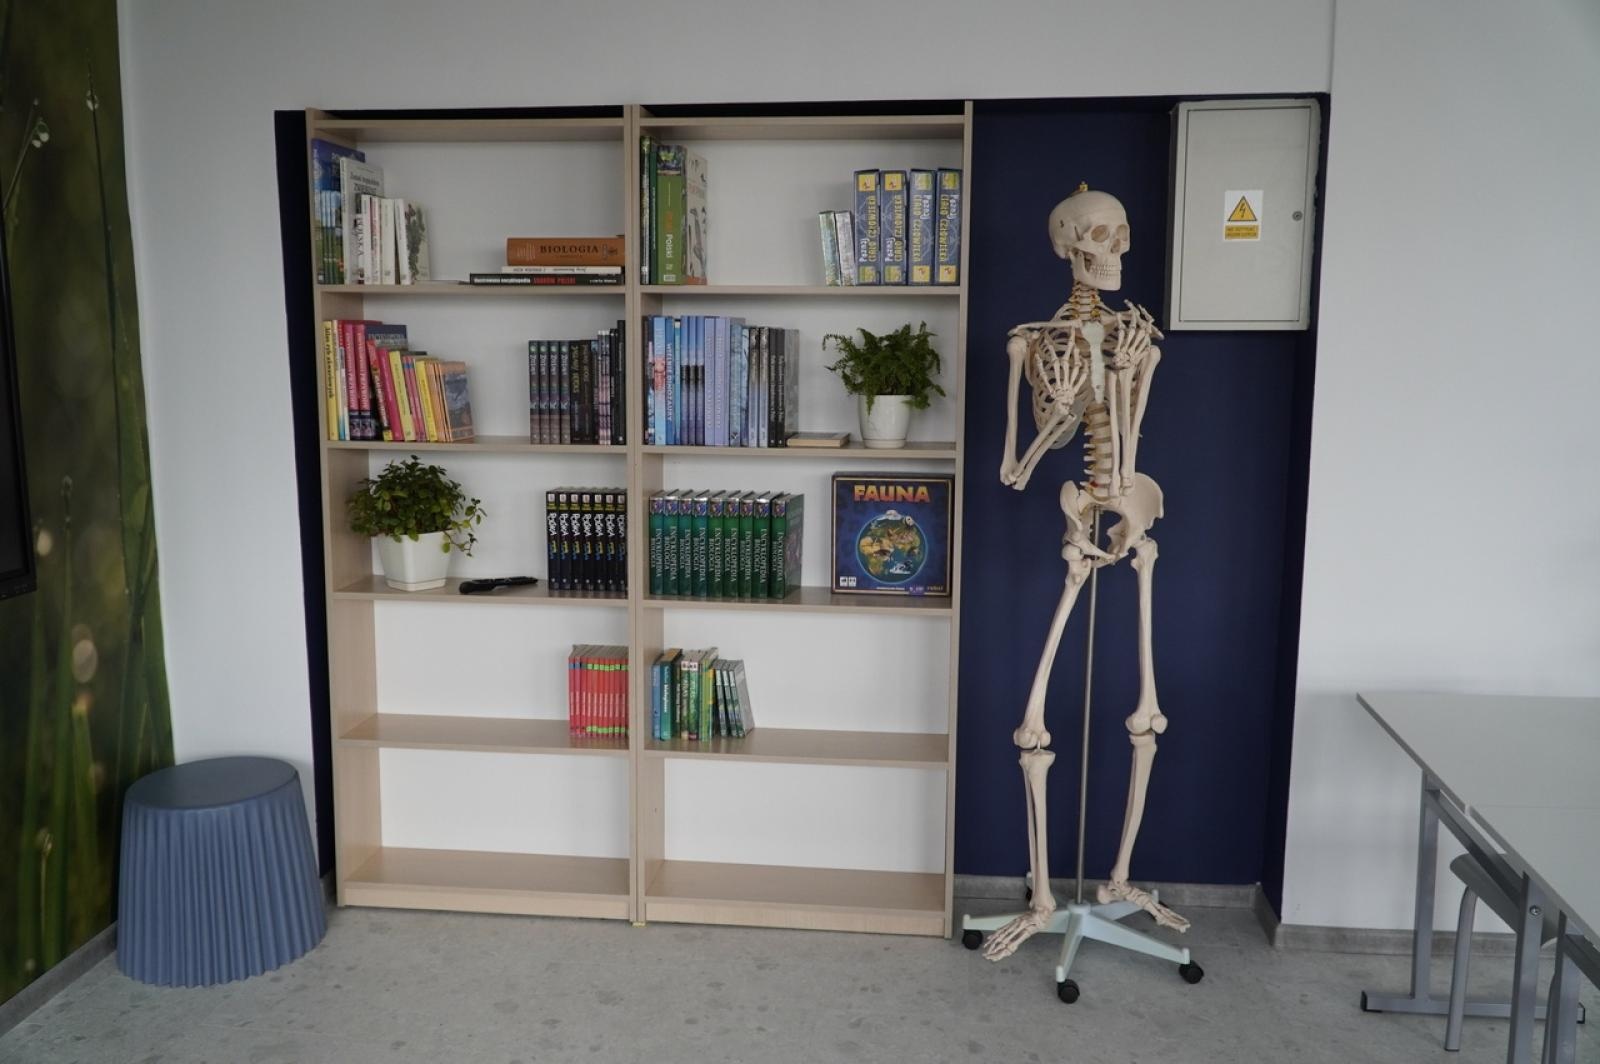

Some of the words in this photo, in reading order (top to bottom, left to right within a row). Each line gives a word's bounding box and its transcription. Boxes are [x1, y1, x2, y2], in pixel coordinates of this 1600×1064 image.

[868, 195, 877, 237] CZŁOWIEKA
[894, 195, 903, 237] CZŁOWIEKA
[920, 195, 932, 219] Poznaj
[947, 195, 960, 219] Poznaj
[540, 245, 599, 254] BIOLOGIA
[664, 234, 673, 258] Polski
[859, 237, 869, 262] Poznaj
[885, 237, 895, 262] Poznaj
[913, 219, 922, 262] CZŁOWIEKA
[939, 219, 949, 262] CZŁOWIEKA
[853, 484, 931, 504] FAUNA
